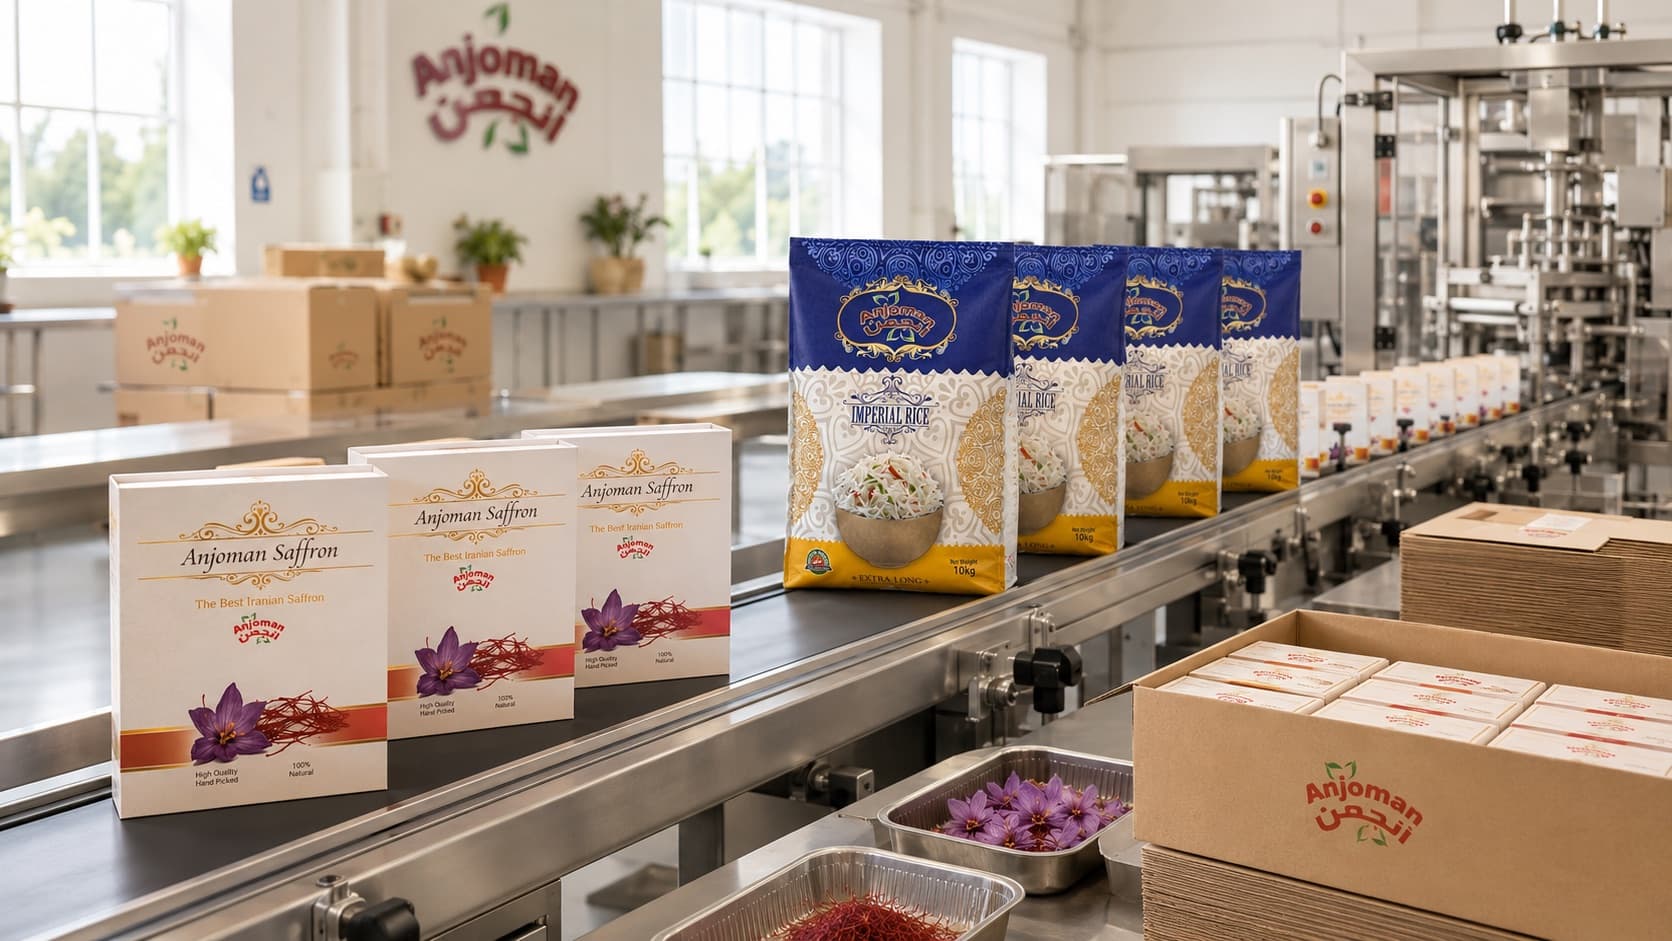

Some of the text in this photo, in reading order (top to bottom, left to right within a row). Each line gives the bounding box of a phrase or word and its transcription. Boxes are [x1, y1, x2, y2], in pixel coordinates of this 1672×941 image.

[411, 33, 580, 114] Anjoman
[428, 89, 566, 145] انجمن
[860, 303, 936, 329] Anjoman
[146, 330, 206, 353] Anjoman
[1035, 391, 1056, 408] RICE
[851, 405, 930, 425] IMPERIAL RICE
[581, 476, 693, 504] Anjoman Saffron
[414, 500, 537, 531] Anjoman Saffron
[590, 524, 605, 533] The
[655, 520, 683, 530] Saffron
[616, 540, 654, 553] Anjoman
[1075, 533, 1094, 543] 10kg
[180, 537, 338, 574] Anjoman Saffron
[423, 547, 526, 562] The Best Iranian Saffron
[453, 570, 495, 585] Anjoman
[858, 574, 923, 585] EXTRA LONG
[954, 565, 976, 578] 10kg
[195, 592, 325, 609] The Best Iranian Saffron
[233, 618, 286, 635] Anjoman
[288, 769, 314, 778] Natural
[292, 761, 311, 769] 100%
[195, 771, 212, 779] High
[195, 777, 239, 787] Hand Picked
[1306, 775, 1423, 827] Anjoman
[1315, 805, 1413, 845] انجمن
